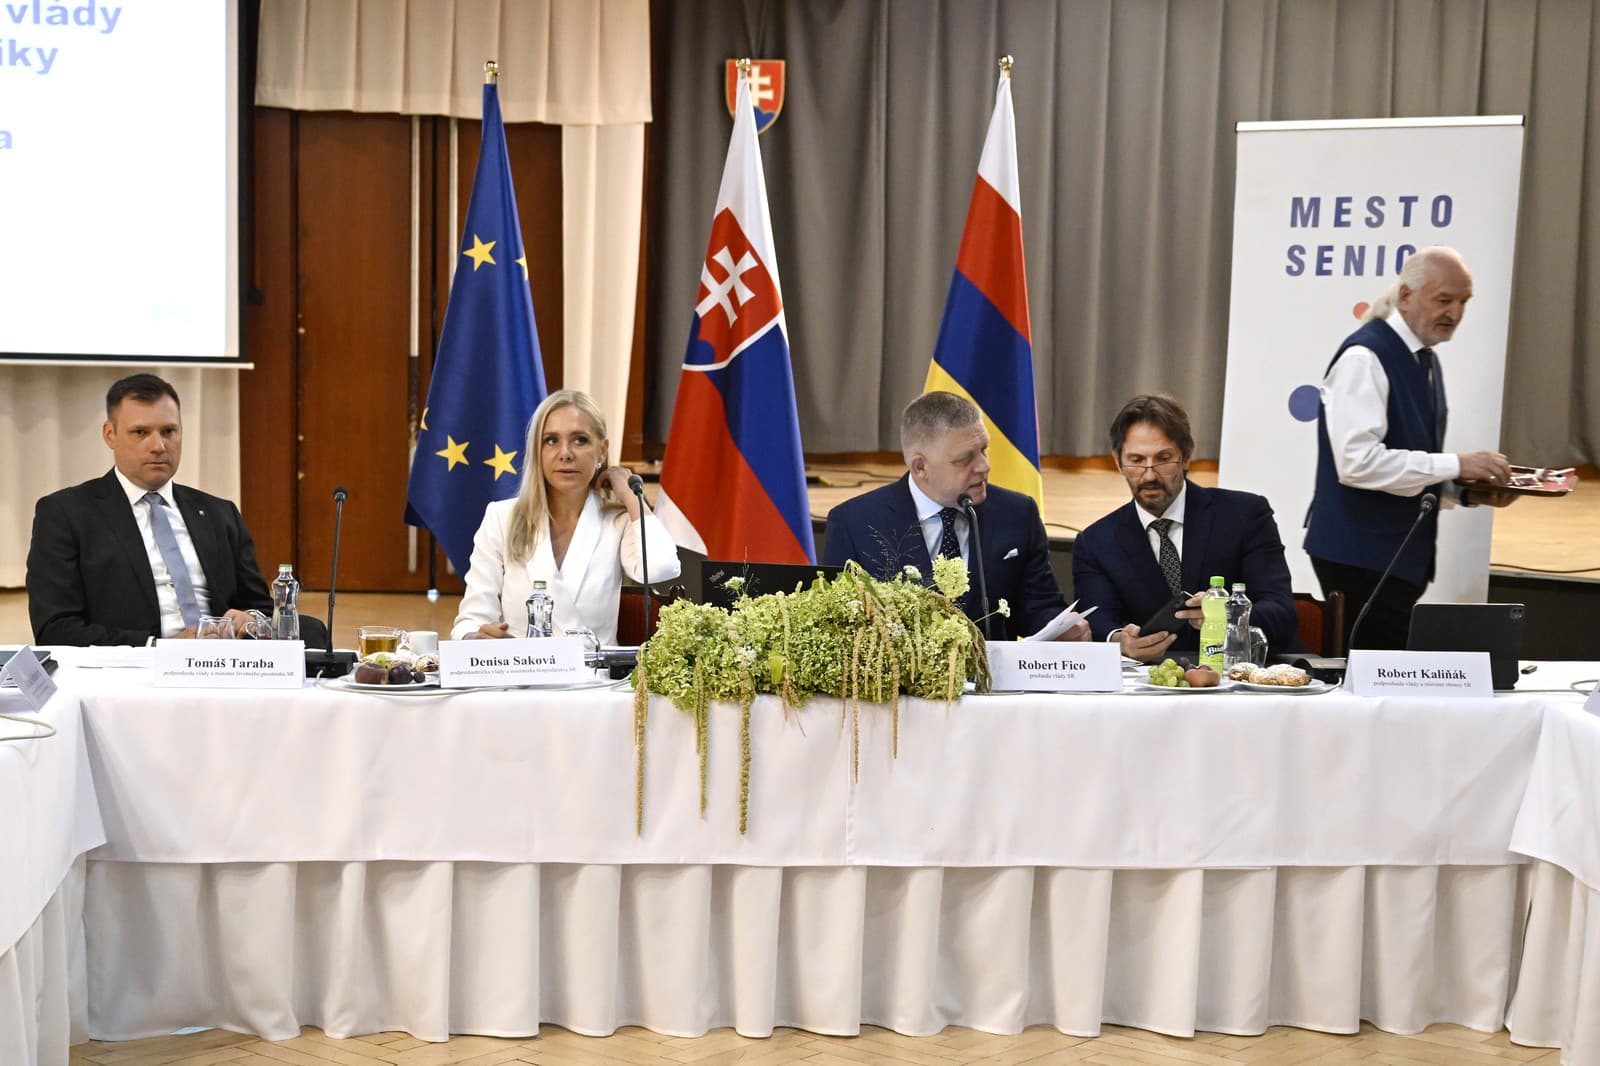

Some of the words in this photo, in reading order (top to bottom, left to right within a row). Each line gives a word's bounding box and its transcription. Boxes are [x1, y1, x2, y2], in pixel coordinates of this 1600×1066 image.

[5, 0, 122, 34] vlády
[1290, 195, 1453, 228] MESTO
[185, 657, 226, 669] Tomáš
[230, 658, 274, 669] Taraba
[470, 656, 510, 668] Denisa
[513, 654, 556, 666] Saková
[1018, 660, 1058, 671] Robert
[1061, 660, 1086, 671] Fico
[1377, 668, 1417, 679] Robert
[1421, 668, 1467, 680] Kaliňák
